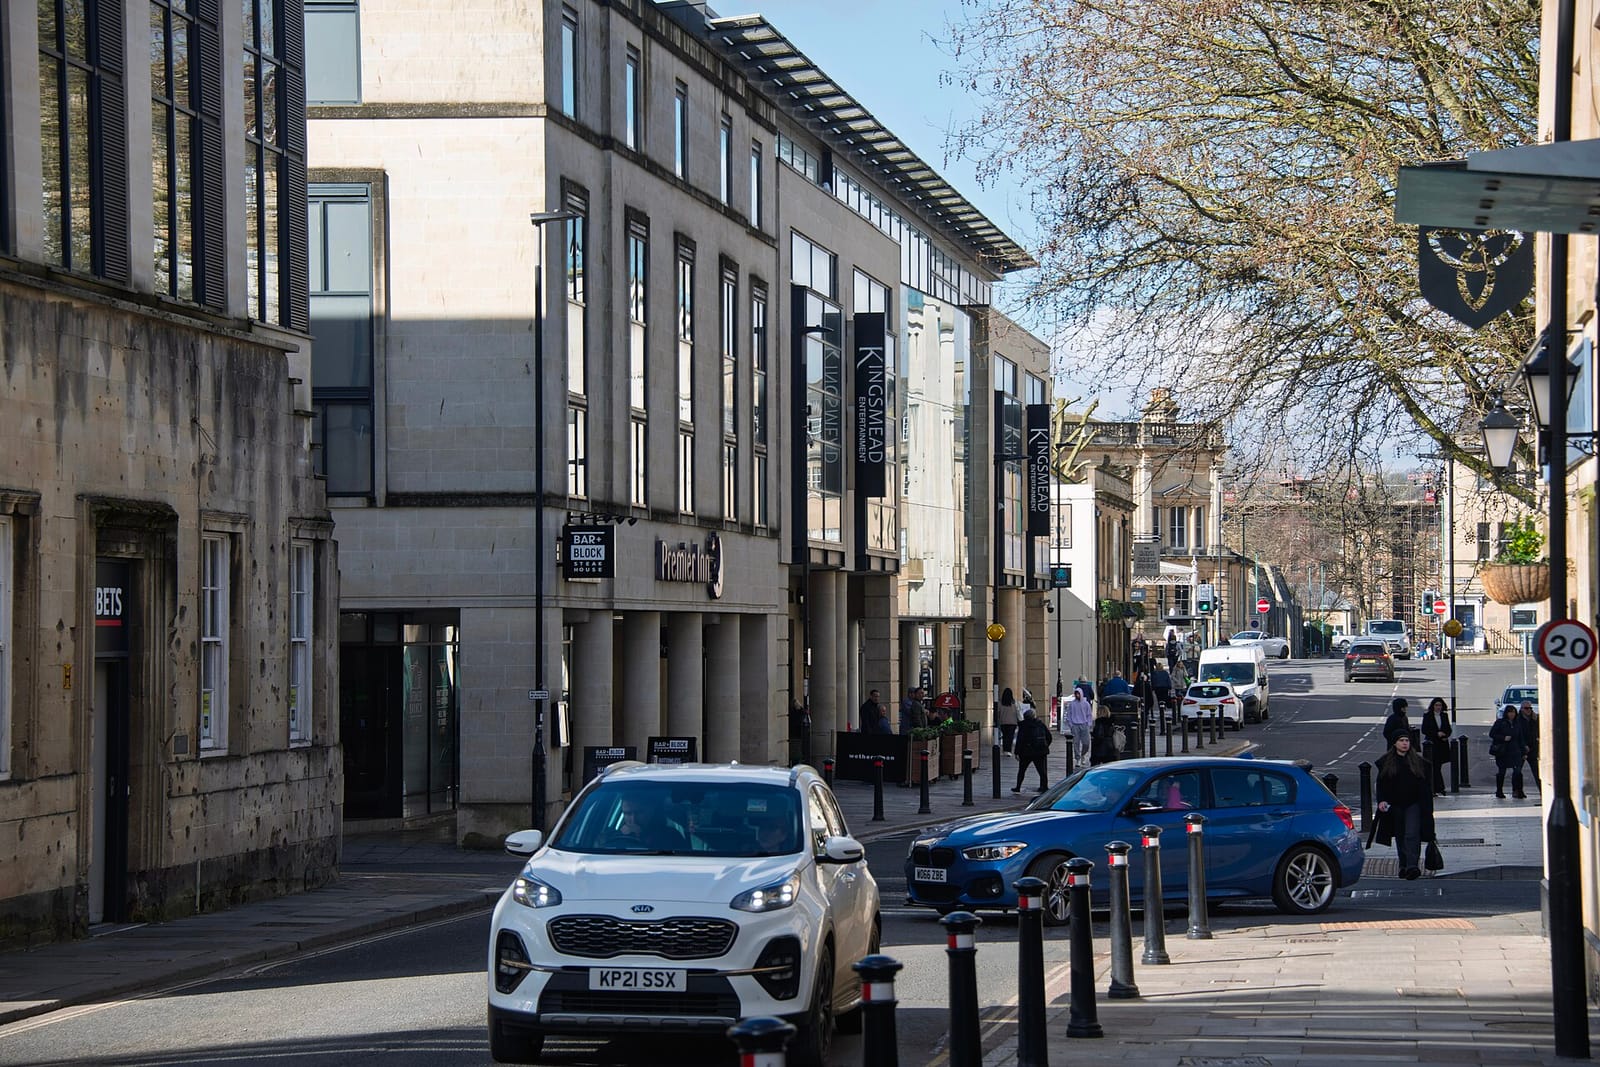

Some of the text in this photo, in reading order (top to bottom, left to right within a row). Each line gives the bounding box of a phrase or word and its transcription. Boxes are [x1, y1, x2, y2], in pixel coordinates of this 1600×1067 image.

[857, 347, 883, 463] KINGSMEAD
[1029, 428, 1048, 512] KINGSMEAD
[573, 535, 602, 544] BAR+
[573, 548, 602, 558] BLOCK
[658, 540, 710, 583] Premier Inn
[96, 587, 122, 616] BETS
[1549, 635, 1589, 660] 20
[600, 971, 676, 988] KP21 SSX
